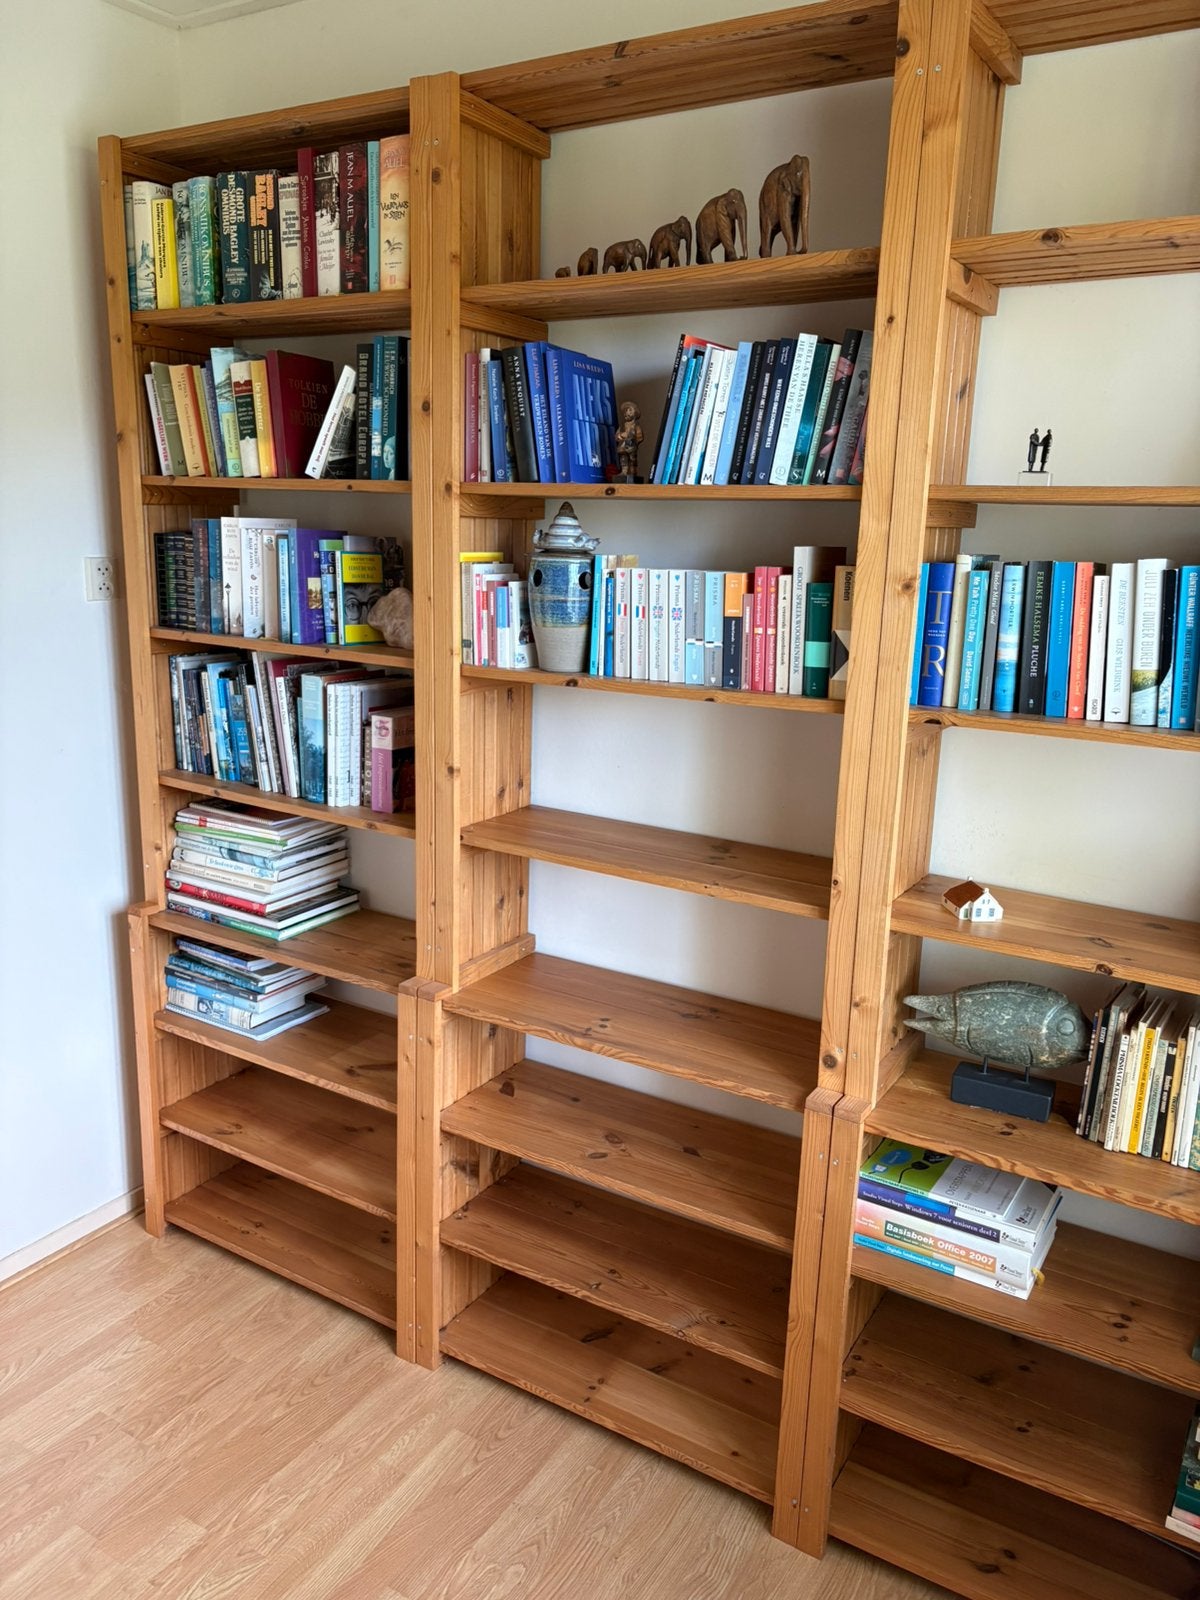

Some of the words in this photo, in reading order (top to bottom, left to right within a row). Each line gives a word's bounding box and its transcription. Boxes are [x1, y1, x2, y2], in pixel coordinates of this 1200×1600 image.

[347, 179, 353, 189] M
[221, 189, 230, 235] OMNIBUS
[228, 175, 237, 223] DESMOND
[236, 188, 245, 222] GROTE
[230, 225, 239, 264] BAGLEY
[359, 353, 368, 388] GRAND
[794, 340, 805, 372] HEREN
[804, 342, 814, 370] HELLA
[255, 382, 261, 391] De
[288, 378, 328, 394] TOLKIEN
[720, 382, 729, 403] Torres
[790, 374, 799, 389] VAN
[301, 393, 317, 409] DE
[359, 391, 368, 422] HOTEL
[517, 381, 525, 417] ENQUIST
[788, 392, 796, 402] DE
[795, 380, 807, 413] HAASSE
[534, 394, 543, 434] VERDWENEN
[782, 405, 793, 429] THEE
[358, 427, 368, 464] EUROPA
[843, 571, 853, 601] Koenen
[974, 577, 980, 585] Me
[1035, 571, 1044, 600] FEMKE
[1119, 580, 1127, 592] DE
[1144, 569, 1157, 588] JULI
[1189, 572, 1198, 596] GÜNTER
[970, 600, 978, 617] Pretty
[1118, 593, 1126, 625] BEESTEN
[1144, 592, 1156, 607] ZEH
[1186, 597, 1195, 627] WALLRAFF
[793, 594, 802, 674] SPREEKWOORDENBOEK
[967, 631, 976, 642] Day
[1032, 602, 1043, 643] HALSEMA
[1142, 612, 1155, 639] ONDER
[922, 644, 946, 677] R
[1030, 645, 1040, 677] PLUCHE
[1140, 641, 1153, 667] BUREN
[964, 668, 972, 689] Sedaris
[1113, 656, 1122, 692] WILBRINK
[1181, 686, 1189, 709] WERELD
[1116, 1050, 1126, 1074] PRISMA
[905, 1203, 933, 1219] Windows
[953, 1219, 979, 1232] senioren
[980, 1226, 992, 1236] deel
[886, 1223, 935, 1246] Basisboek
[938, 1240, 966, 1256] Office
[969, 1251, 994, 1265] 2007
